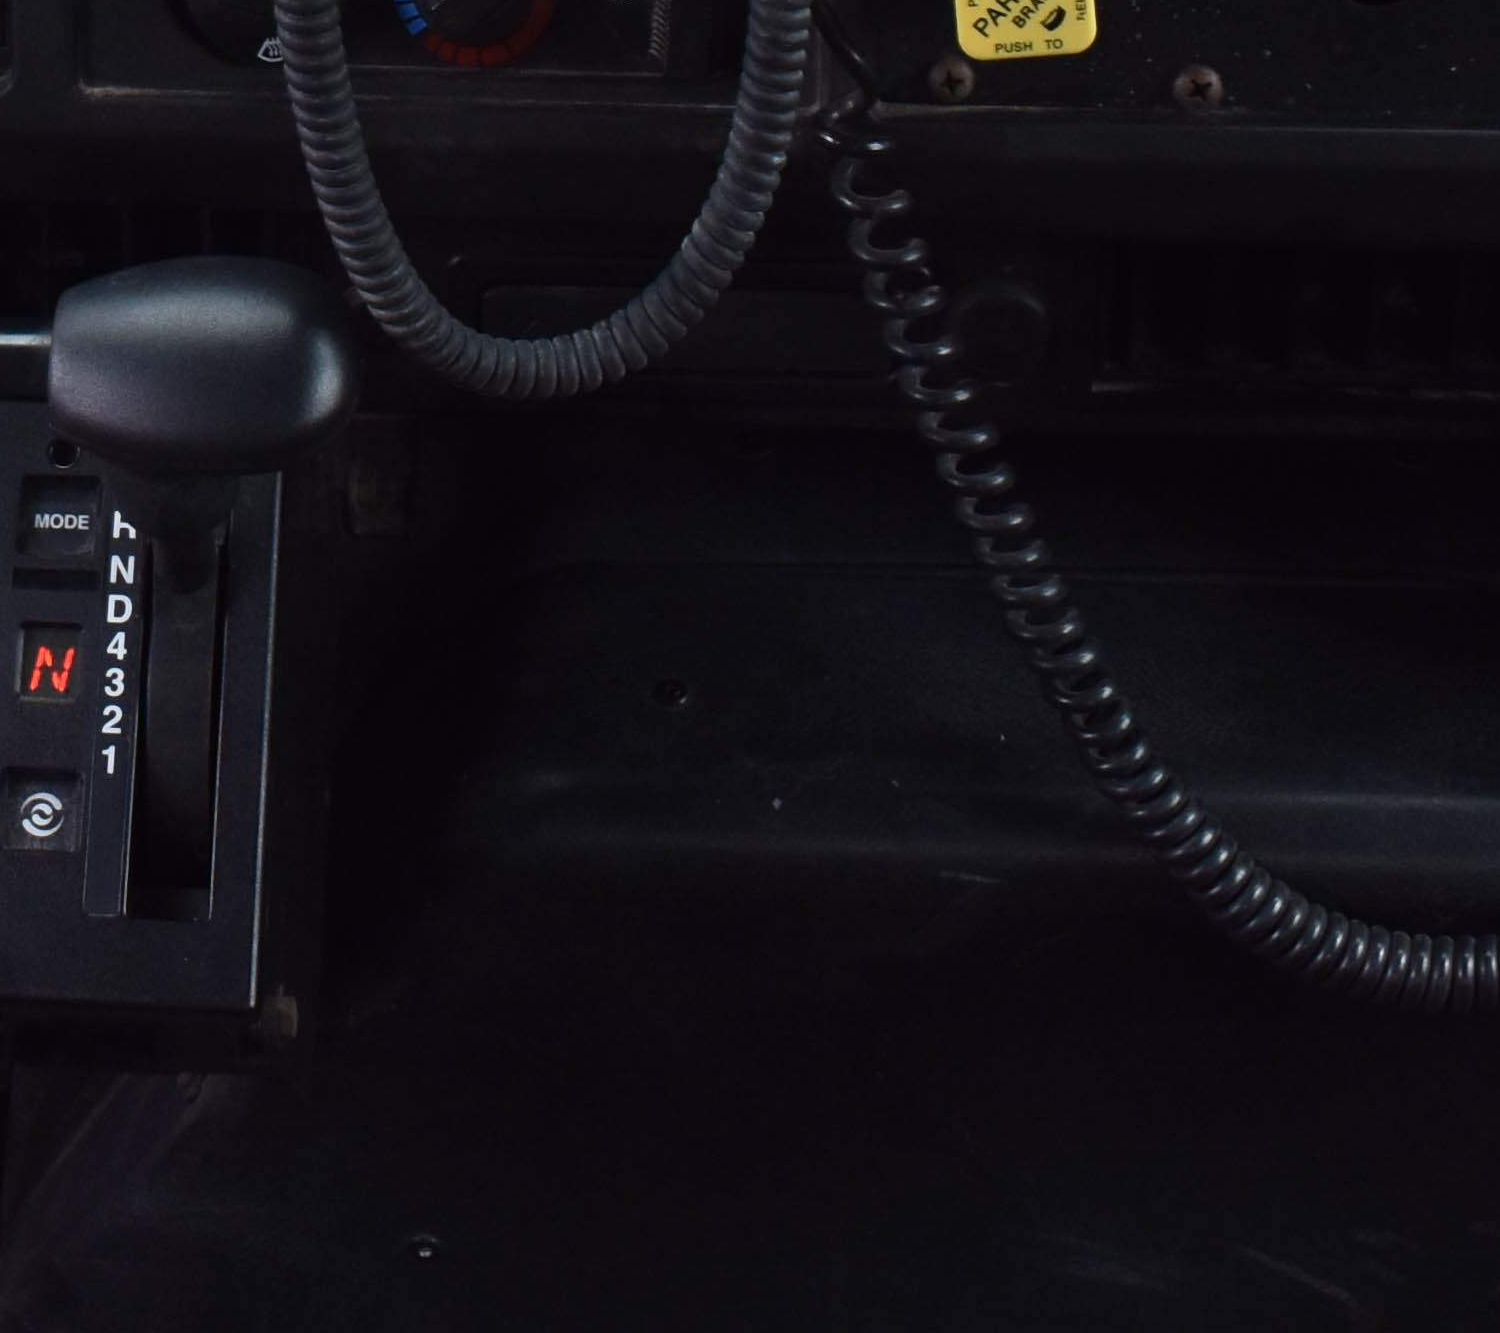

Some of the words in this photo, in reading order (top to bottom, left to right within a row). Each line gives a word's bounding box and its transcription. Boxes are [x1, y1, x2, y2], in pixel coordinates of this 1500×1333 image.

[994, 41, 1033, 53] PUSH
[1044, 38, 1063, 50] TO
[34, 512, 89, 531] MODE
[109, 556, 135, 584] N
[107, 595, 133, 623] D
[106, 633, 127, 661] 4
[29, 646, 75, 693] N
[104, 669, 125, 696] 3
[102, 706, 122, 733] 2
[102, 746, 118, 773] 1
